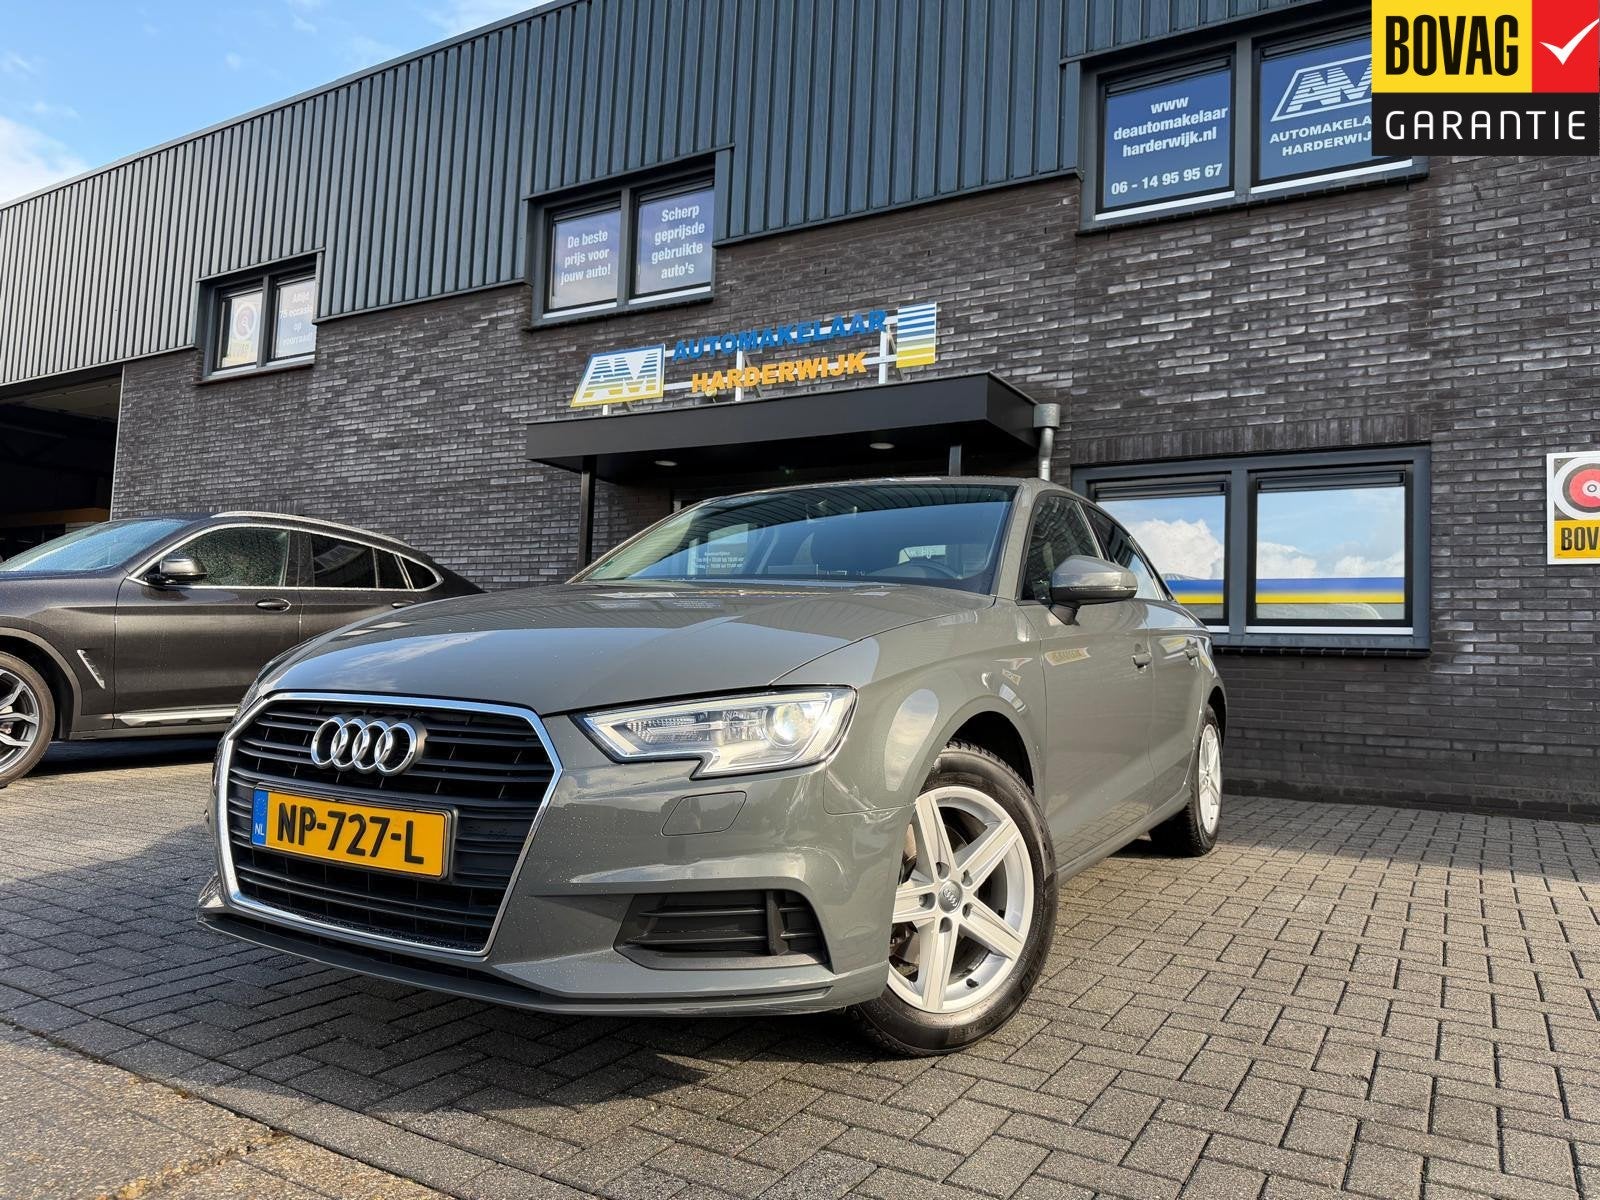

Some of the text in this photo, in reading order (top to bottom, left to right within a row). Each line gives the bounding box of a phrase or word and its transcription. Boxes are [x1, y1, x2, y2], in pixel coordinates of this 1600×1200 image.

[1150, 97, 1189, 114] www
[1113, 107, 1229, 141] deautomakelaar
[1269, 115, 1372, 144] AUTOMAKELA
[1122, 127, 1217, 157] harderwijk.nl
[1282, 131, 1372, 156] HARDERWIJ
[1111, 181, 1128, 195] 06
[1142, 175, 1159, 189] 14
[1162, 171, 1180, 186] 95
[1183, 167, 1201, 182] 95
[1204, 163, 1223, 178] 67
[661, 205, 700, 223] Scherp
[567, 230, 608, 249] De beste
[654, 222, 706, 246] geprijsde
[564, 248, 610, 269] prijs voor
[651, 242, 704, 265] gebruikte
[560, 263, 611, 286] jouw auto!
[661, 262, 695, 280] auto's
[672, 309, 888, 362] AUTOMAKELAAR
[691, 351, 869, 393] HARDERWIJK
[1561, 526, 1600, 551] BOV
[255, 824, 265, 836] NL
[277, 802, 425, 865] NP-727-L
